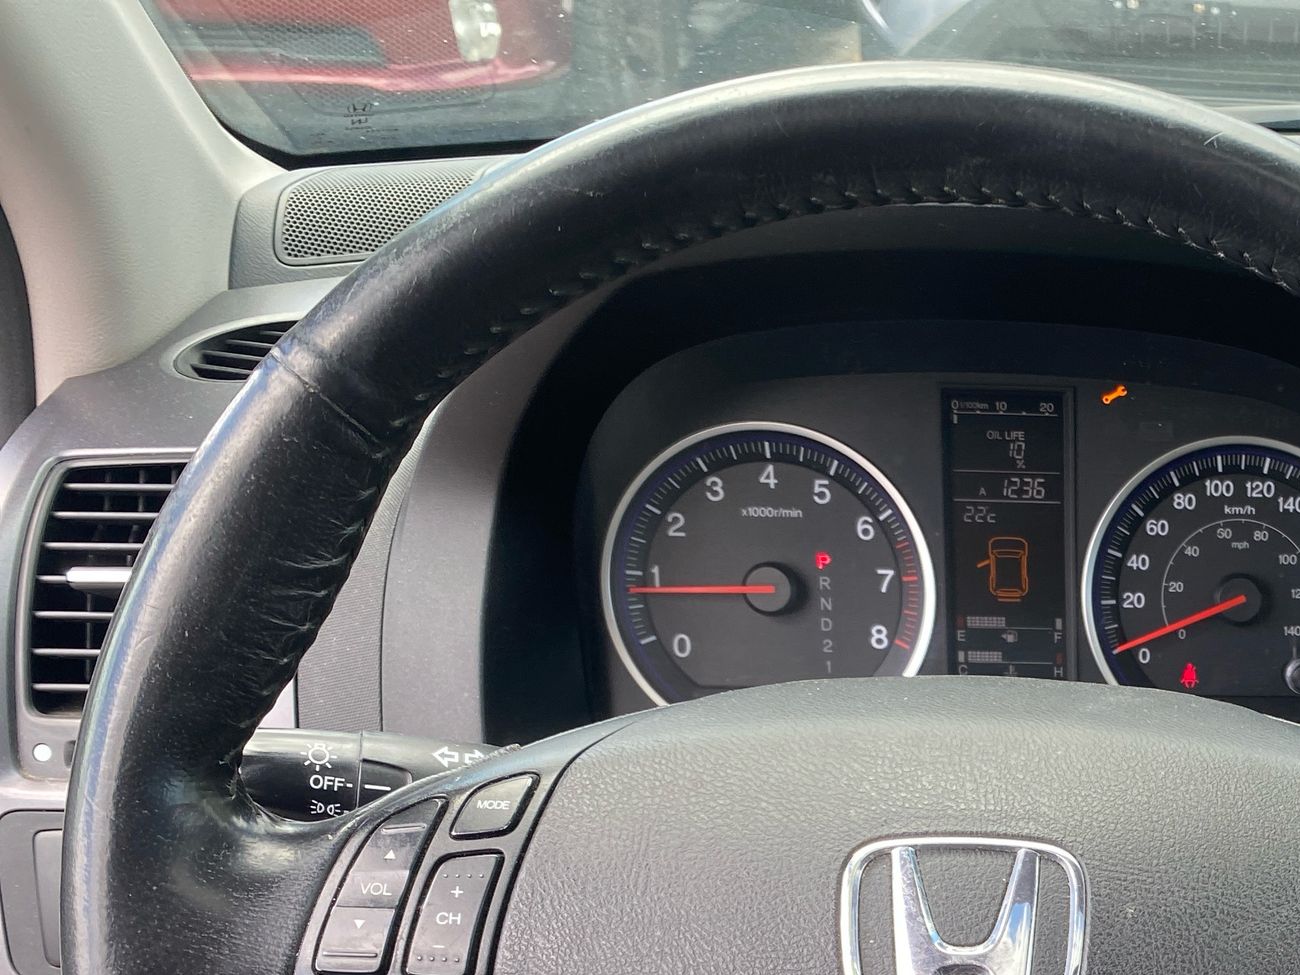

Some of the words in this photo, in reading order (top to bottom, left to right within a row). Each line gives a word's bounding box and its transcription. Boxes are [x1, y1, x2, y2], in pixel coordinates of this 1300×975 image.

[996, 401, 1007, 411] 10
[1040, 402, 1054, 412] 20
[986, 430, 1002, 440] OIL
[1005, 431, 1025, 441] LIFE
[1009, 441, 1025, 459] 10
[760, 464, 778, 489] 4
[706, 477, 725, 501] 3
[813, 480, 831, 504] 5
[1003, 477, 1046, 499] 1236
[1205, 479, 1234, 497] 100
[1246, 481, 1275, 498] 120
[1173, 493, 1197, 510] 80
[741, 507, 803, 519] x1000r/min
[1224, 505, 1256, 516] km/h
[667, 512, 686, 537] 2
[857, 517, 875, 541] 6
[1146, 520, 1169, 537] 60
[1253, 530, 1269, 542] 80
[1184, 546, 1200, 557] 40
[1231, 540, 1250, 550] mph
[815, 552, 832, 569] P
[1127, 554, 1149, 571] 40
[1278, 554, 1297, 565] 100
[651, 565, 661, 587] 1
[819, 577, 831, 590] R
[876, 569, 894, 593] 7
[1168, 582, 1184, 593] 20
[820, 597, 832, 611] N
[1123, 592, 1145, 609] 20
[821, 618, 833, 632] D
[871, 625, 889, 650] 8
[957, 630, 966, 641] E
[1054, 632, 1063, 643] F
[1178, 629, 1186, 640] 0
[673, 634, 691, 658] 0
[822, 640, 833, 653] 2
[1138, 648, 1150, 664] 0
[1054, 666, 1064, 677] H
[309, 774, 346, 791] OFF
[476, 800, 511, 810] MODE
[360, 883, 392, 897] VOL
[435, 912, 461, 926] CH
